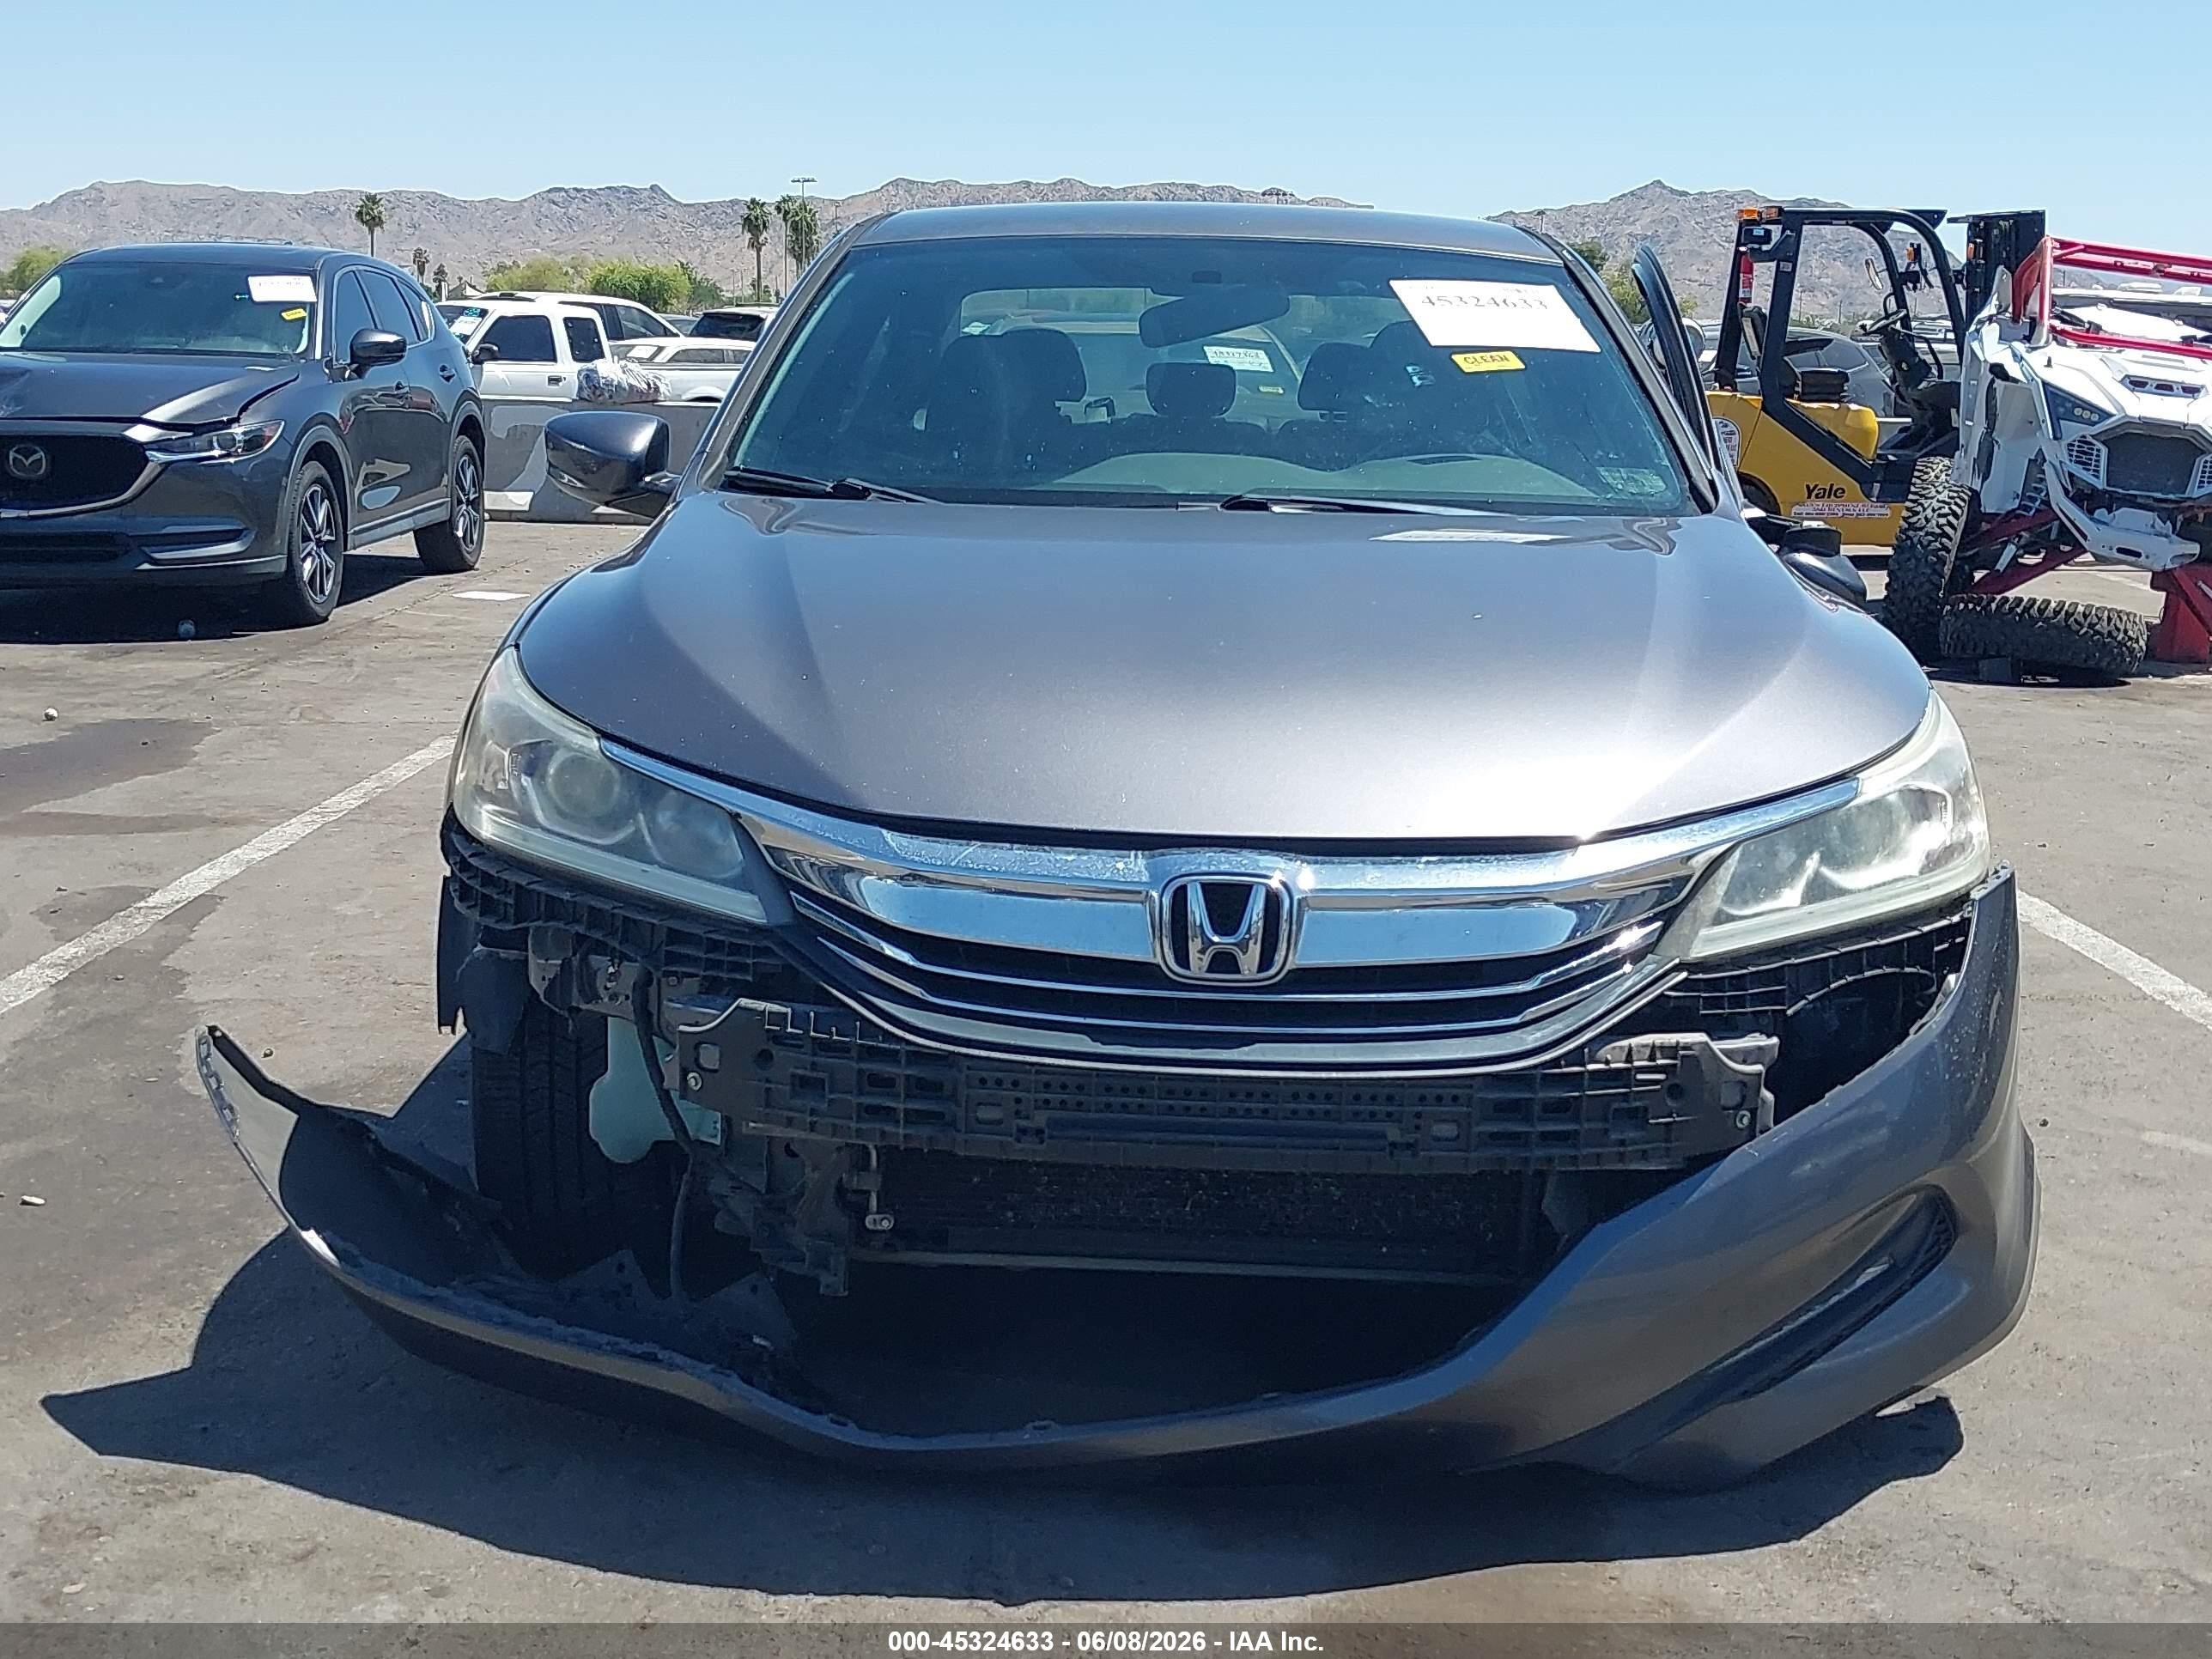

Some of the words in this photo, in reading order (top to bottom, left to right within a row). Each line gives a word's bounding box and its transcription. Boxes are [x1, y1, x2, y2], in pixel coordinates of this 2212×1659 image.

[1421, 295, 1548, 310] 45324633
[1463, 354, 1510, 365] CLEAN
[1805, 483, 1846, 500] Yale
